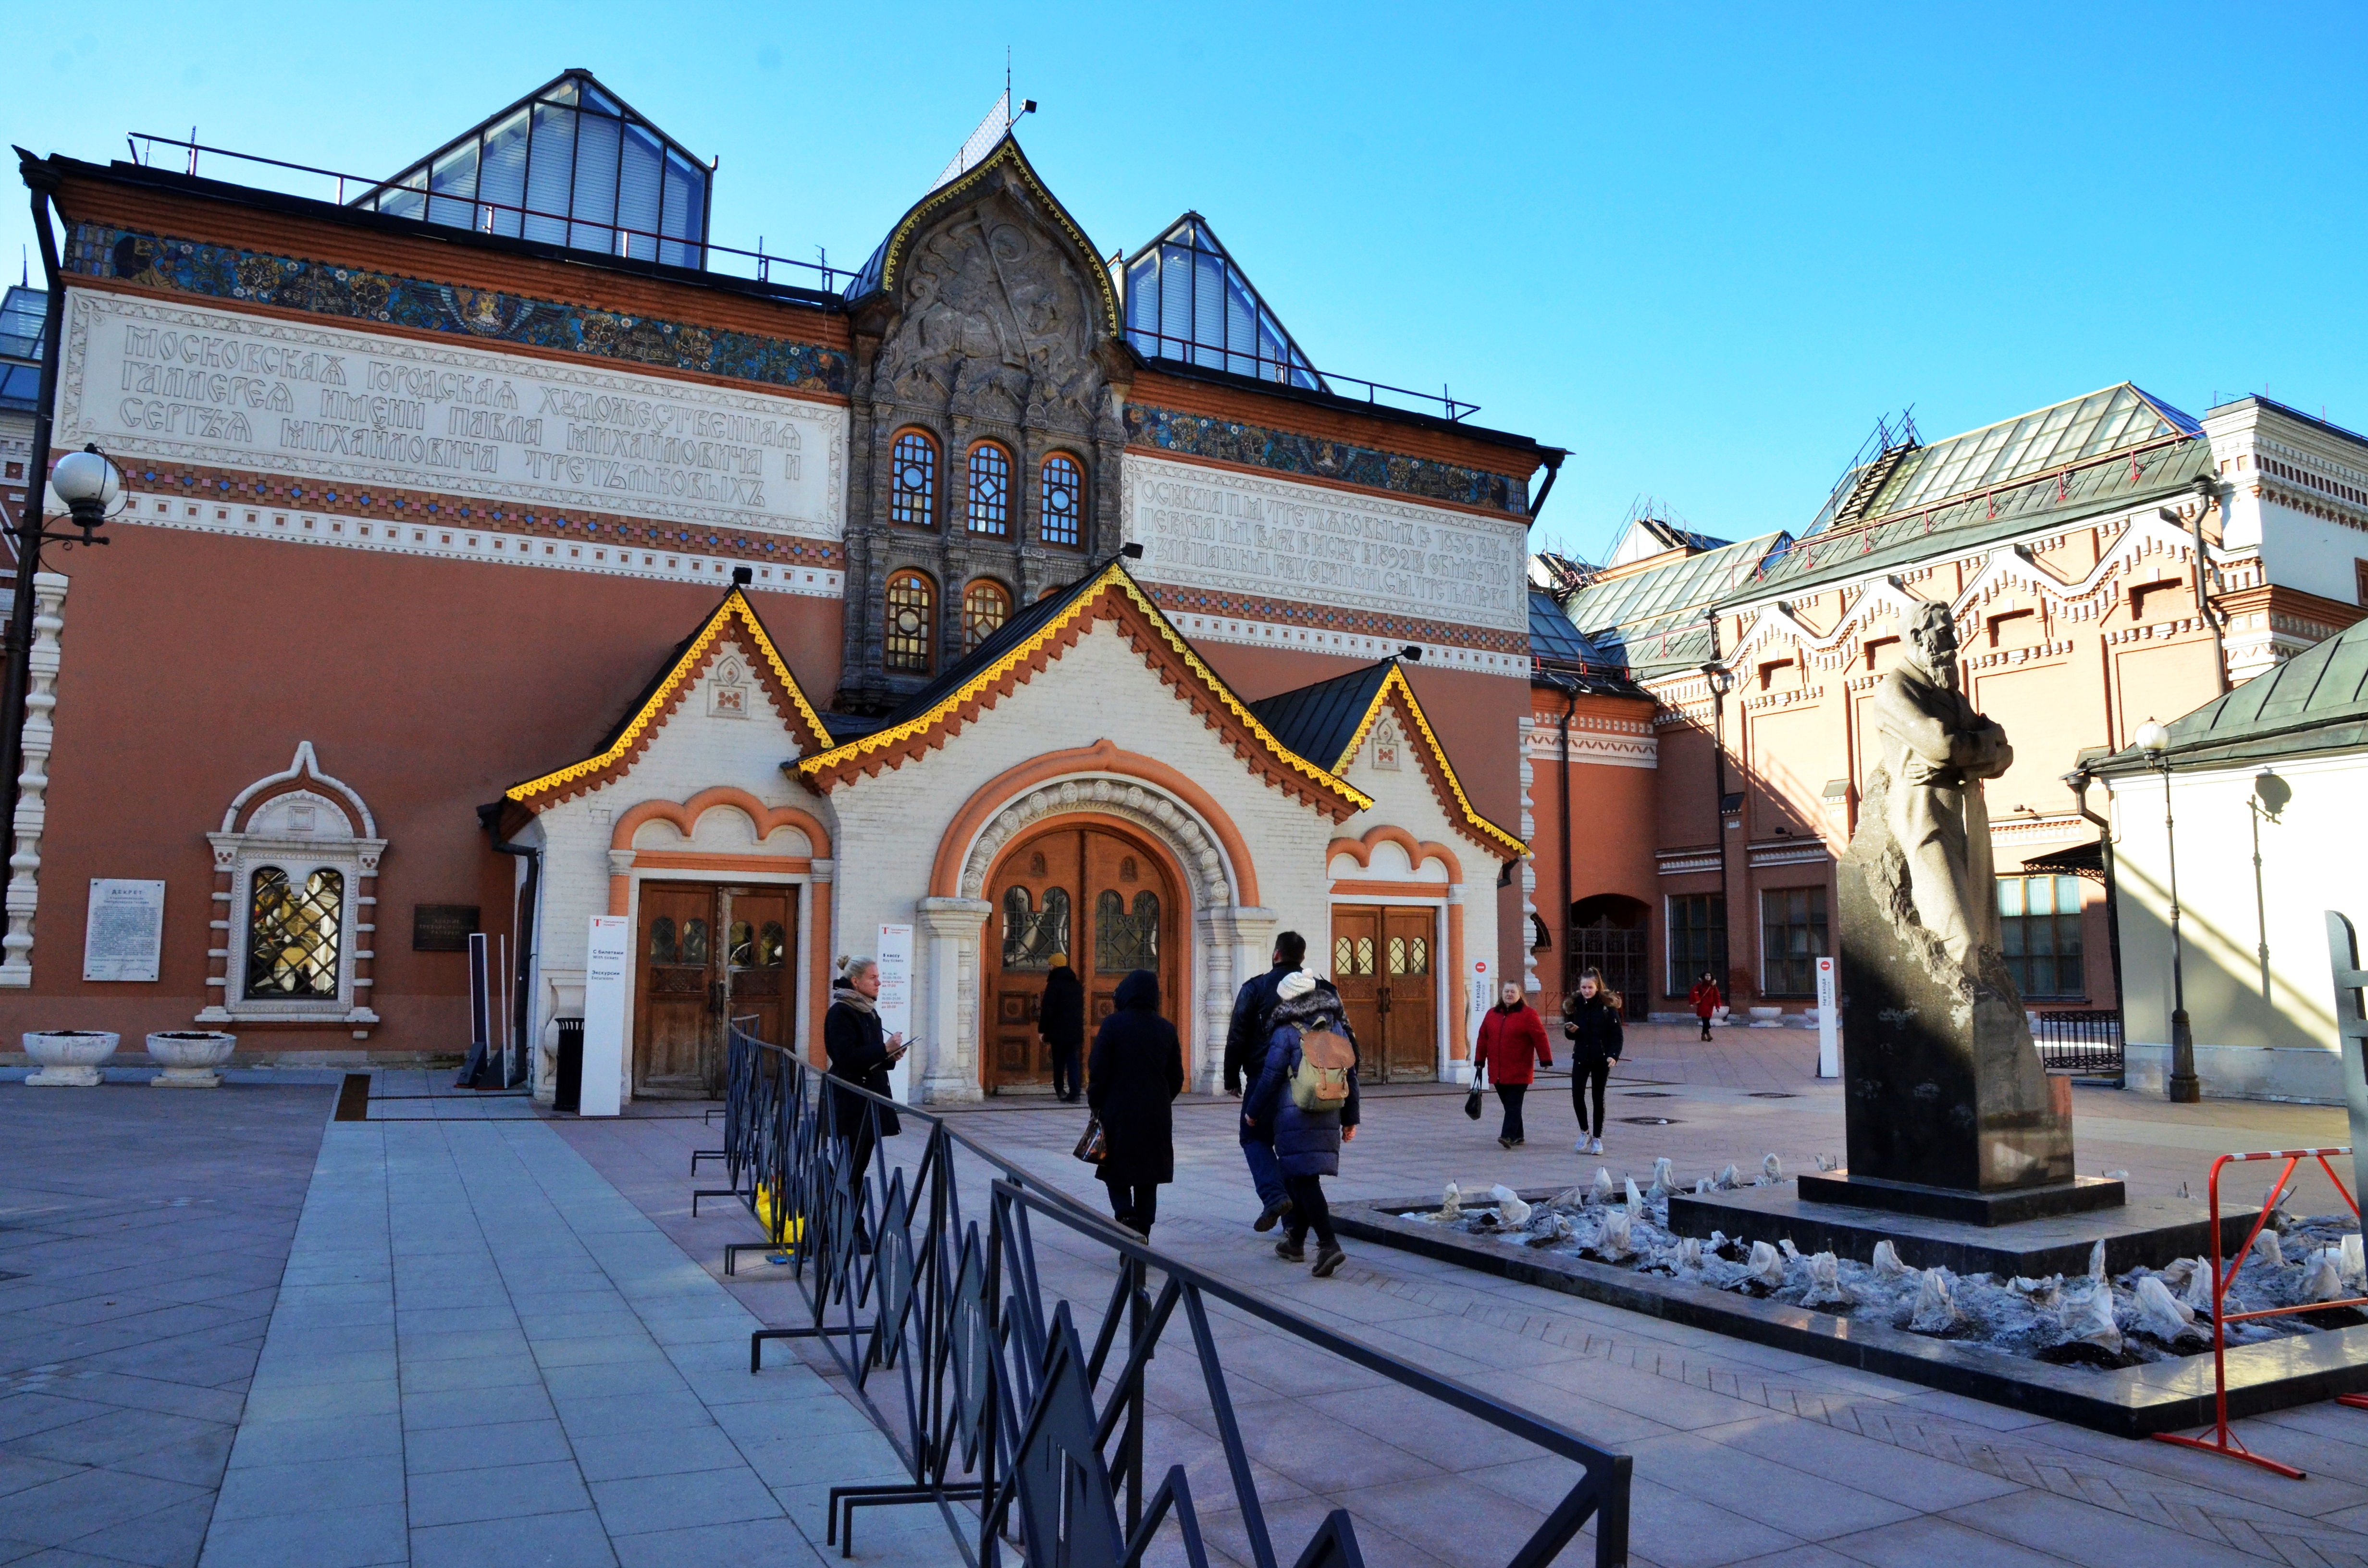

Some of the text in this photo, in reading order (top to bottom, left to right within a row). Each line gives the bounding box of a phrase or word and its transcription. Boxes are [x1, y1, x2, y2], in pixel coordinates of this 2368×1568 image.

[125, 325, 346, 385] МОСКОВСКАЯ
[367, 361, 518, 409] ГОРОДСКАЯ
[122, 360, 801, 480] ГАЛЛЕРЕЯ ИМЕНИ ПАВЛА МИХАЙЛОВИЧА И
[281, 418, 498, 473] МИХАЙЛОВИЧА
[1371, 544, 1410, 571] 1892
[1435, 529, 1474, 554] 1856
